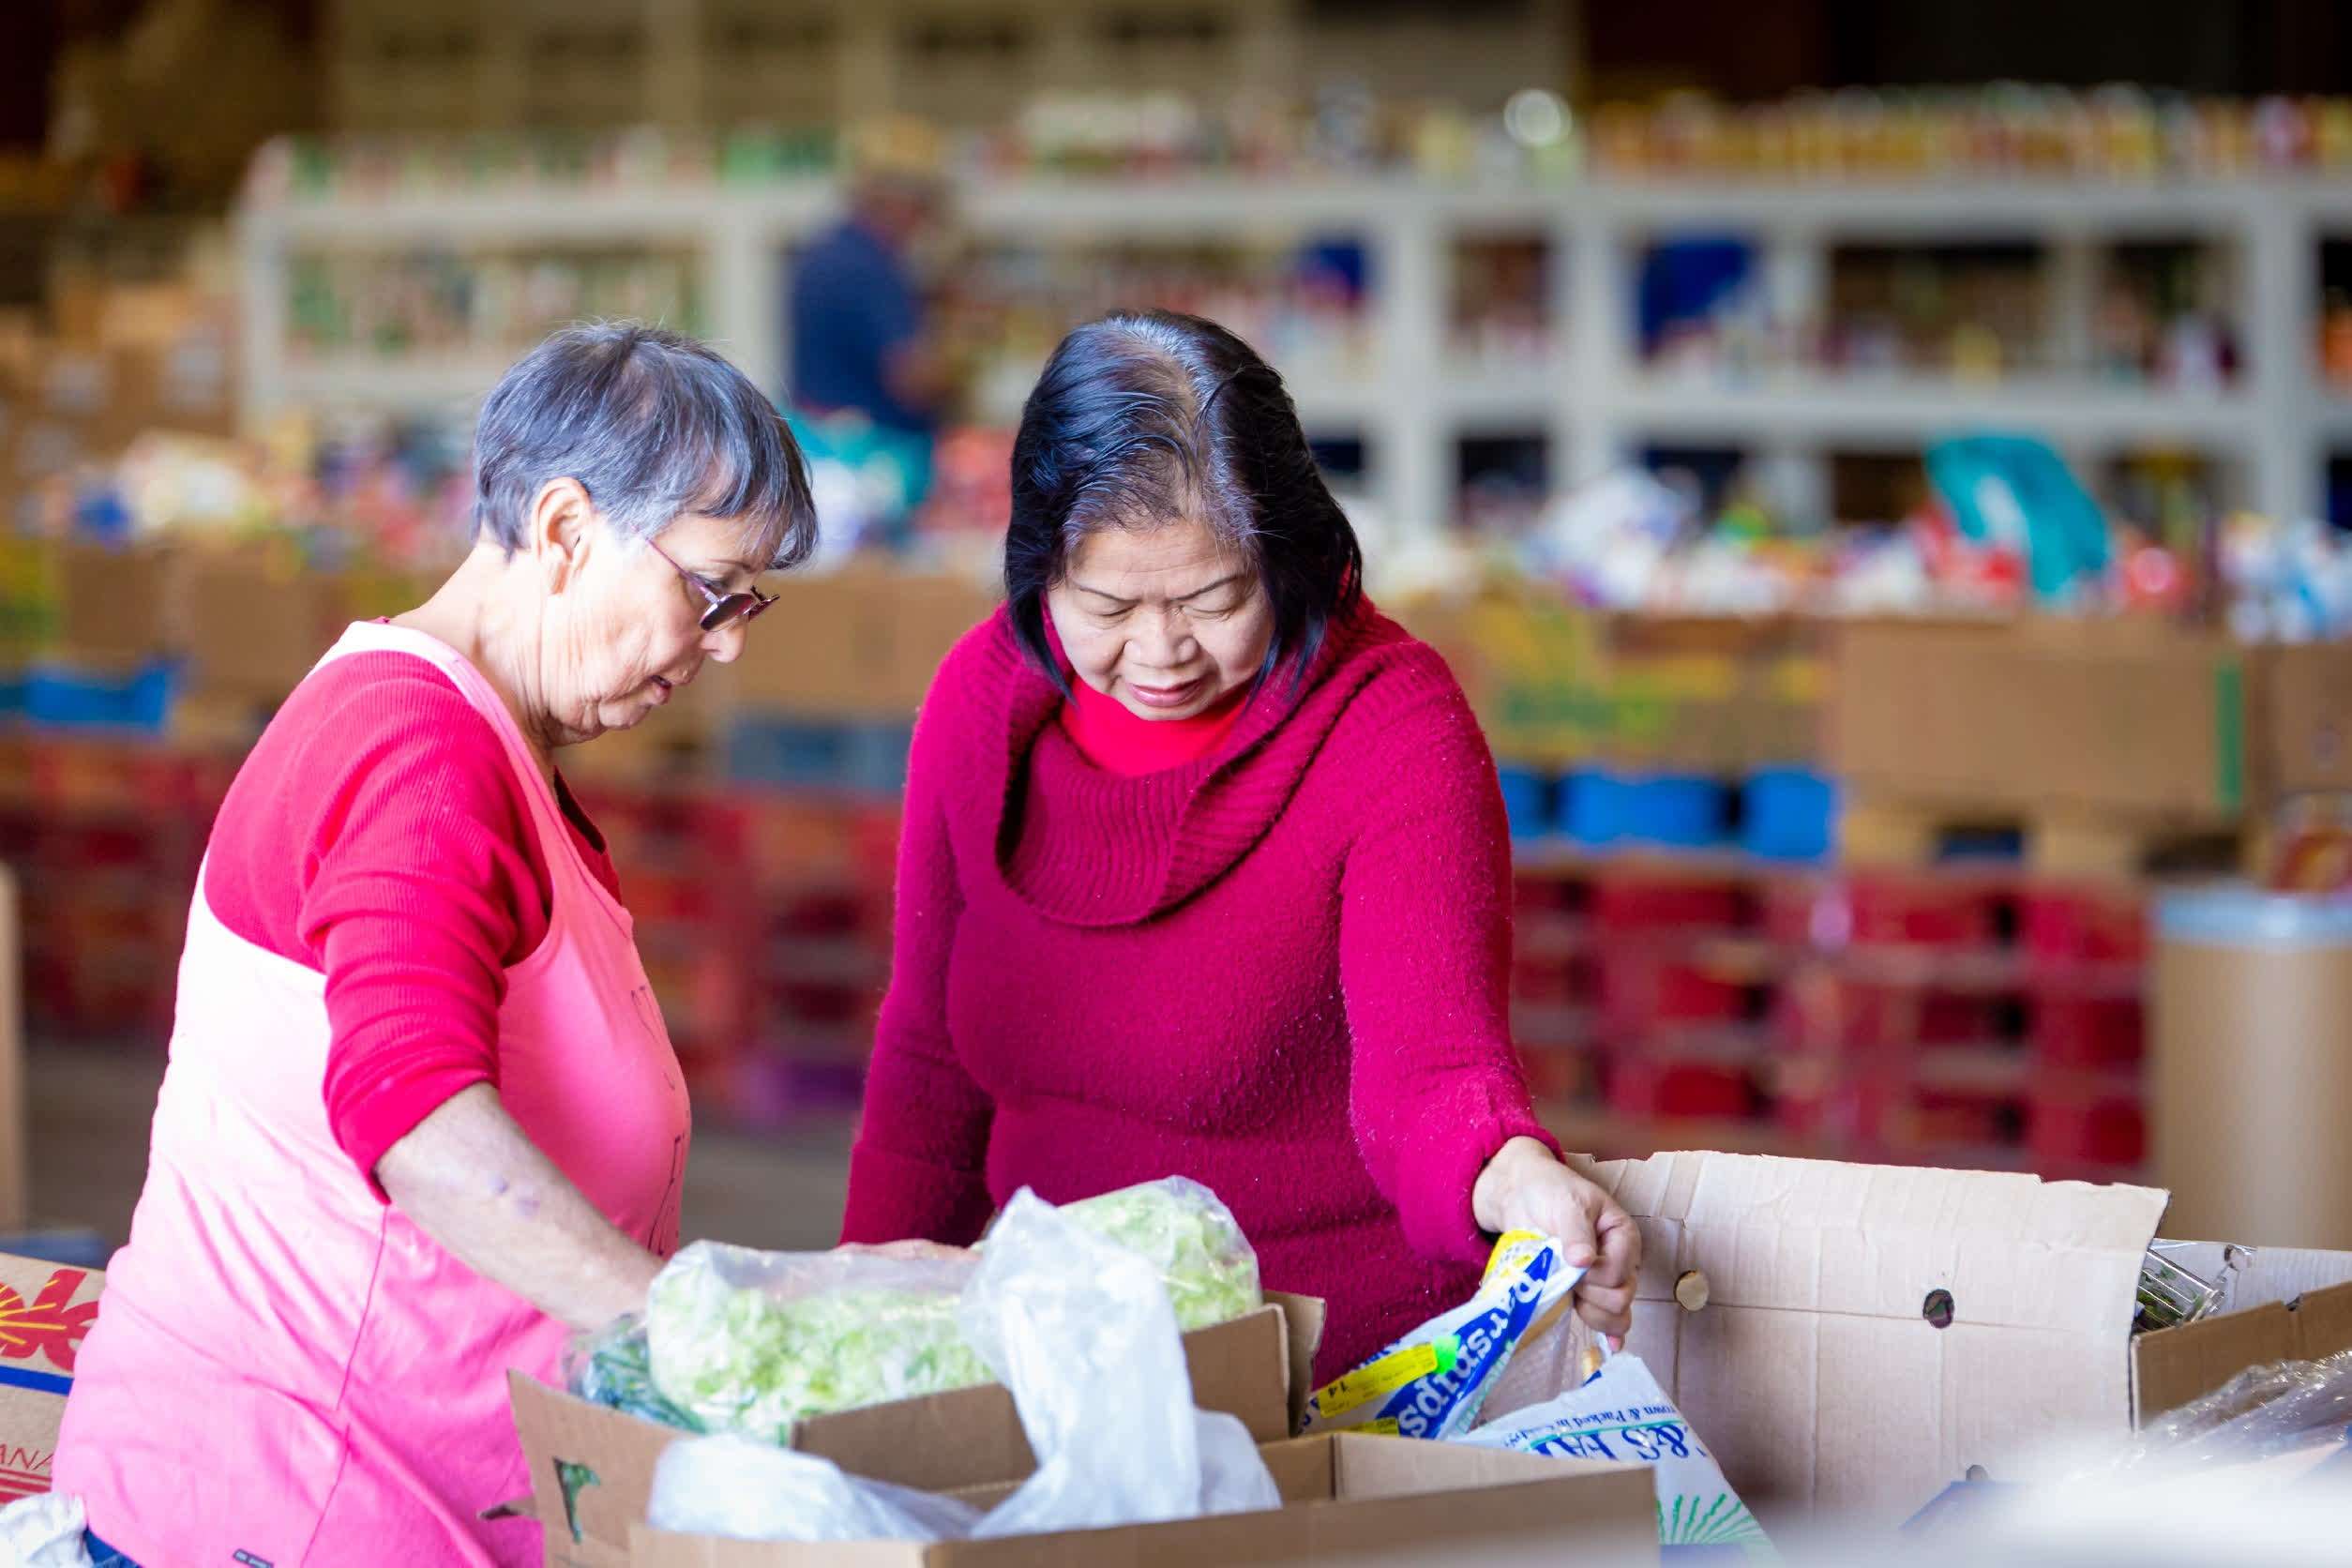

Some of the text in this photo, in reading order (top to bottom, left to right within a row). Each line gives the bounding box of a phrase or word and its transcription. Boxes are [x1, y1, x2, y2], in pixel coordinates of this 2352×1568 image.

[1573, 1409, 1624, 1424] Packed
[1625, 1408, 1641, 1422] &
[1645, 1404, 1677, 1416] rown
[1620, 1425, 1707, 1460] &S
